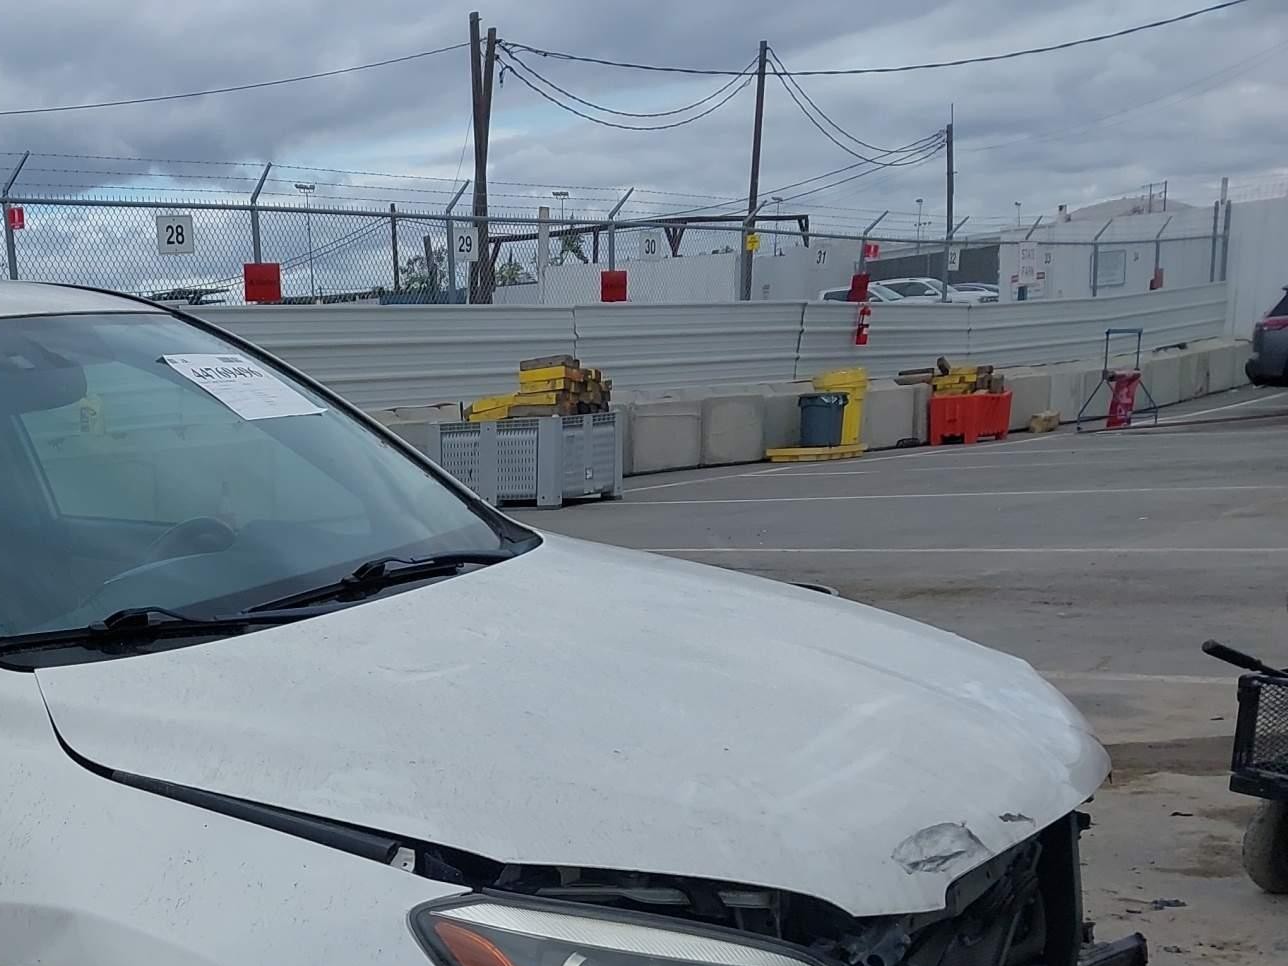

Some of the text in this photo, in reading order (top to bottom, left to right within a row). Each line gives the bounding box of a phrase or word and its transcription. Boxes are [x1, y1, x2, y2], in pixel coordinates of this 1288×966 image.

[165, 224, 185, 245] 28
[458, 235, 473, 253] 29
[644, 239, 656, 255] 30
[816, 250, 827, 264] 31
[190, 366, 265, 381] 44769496
